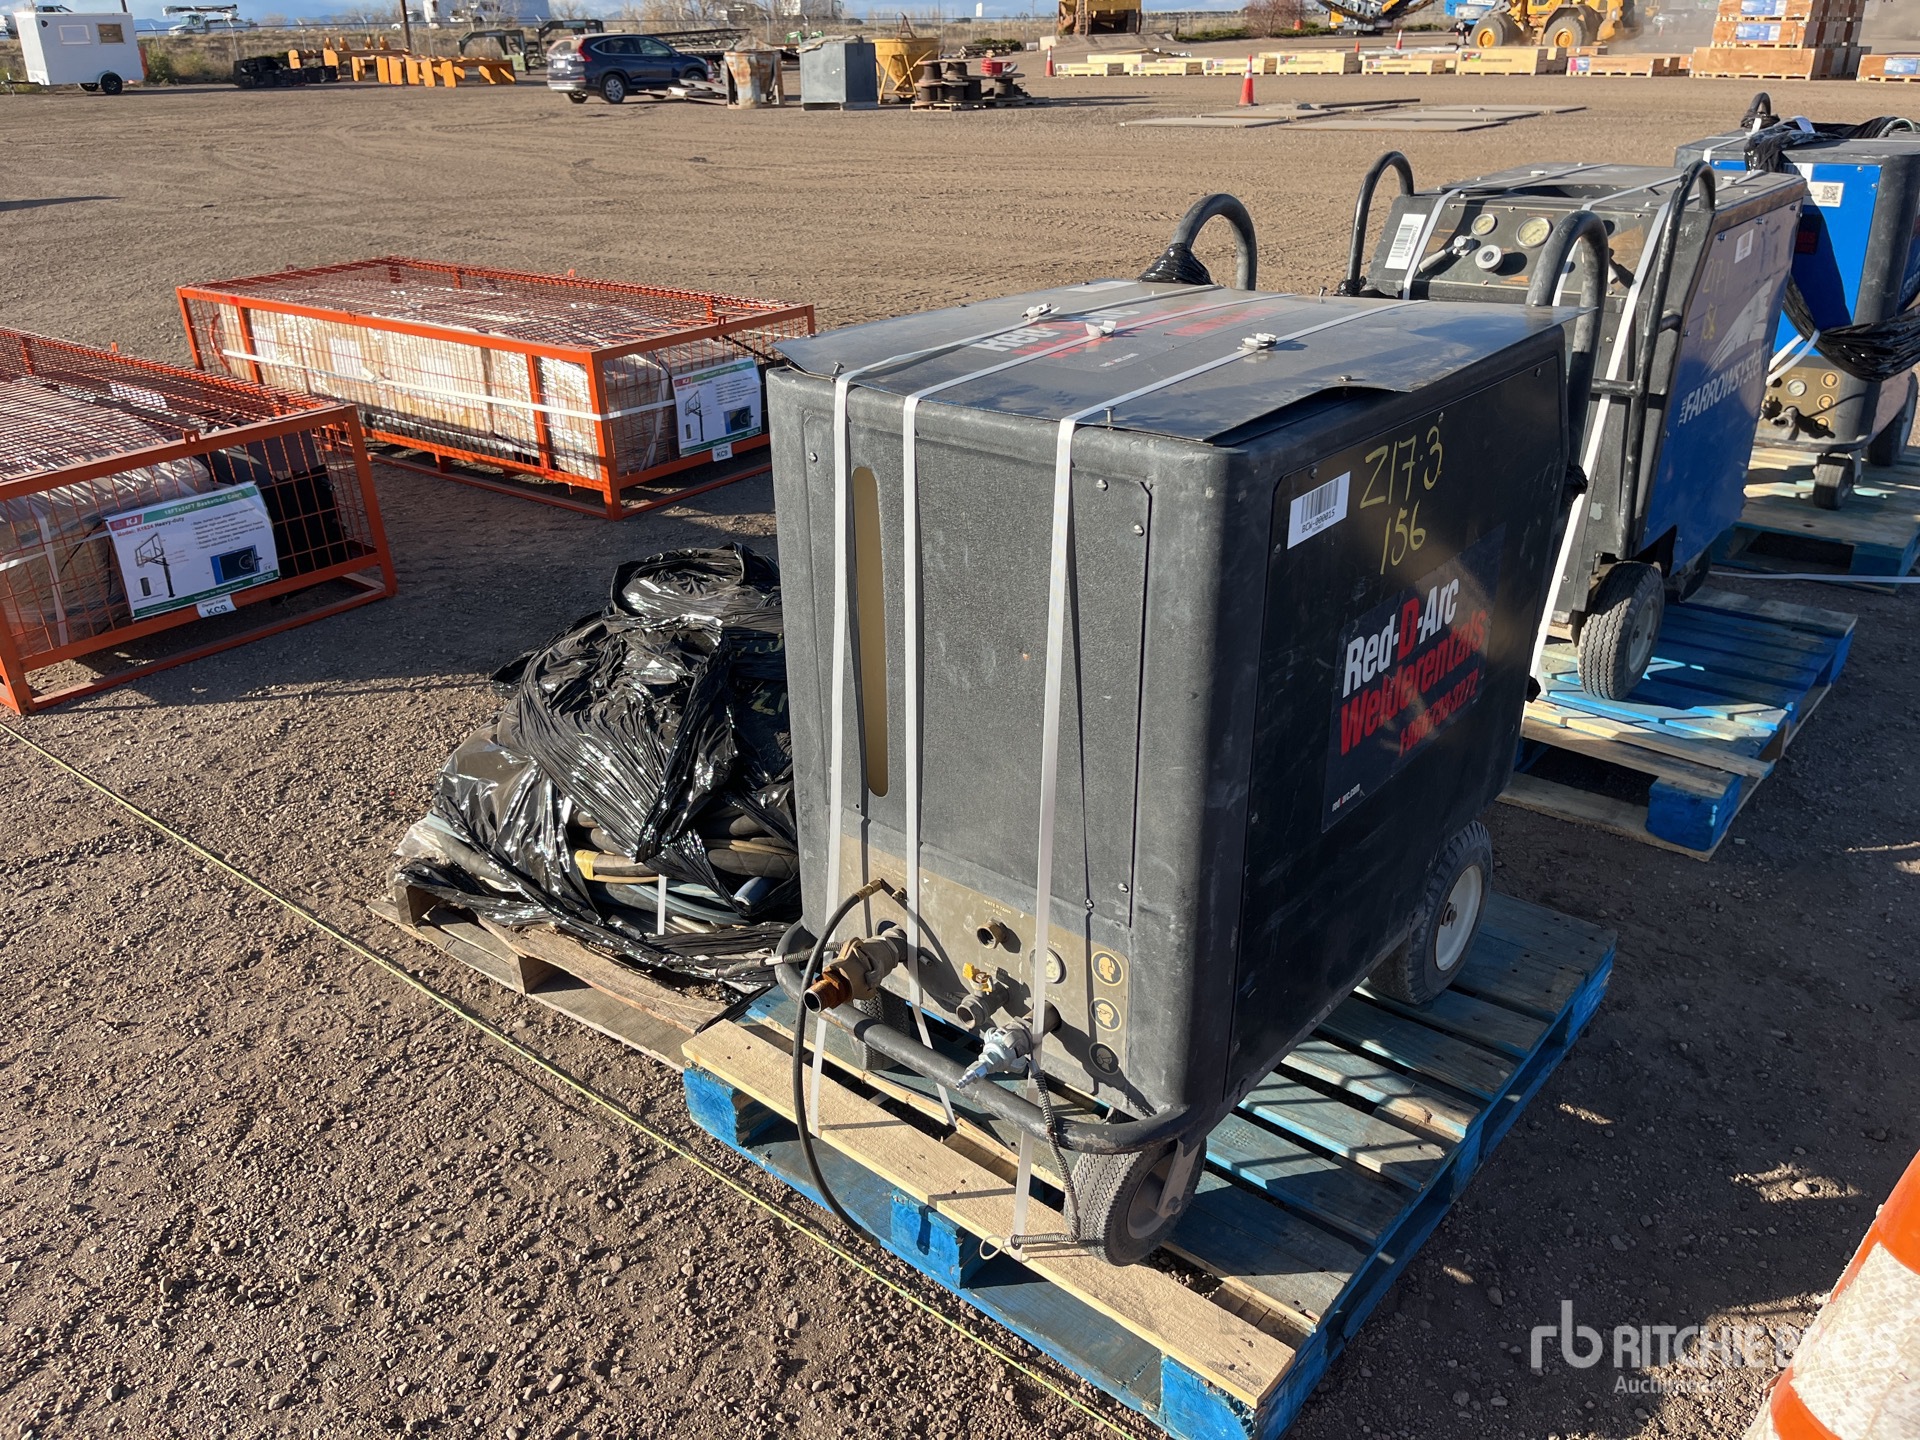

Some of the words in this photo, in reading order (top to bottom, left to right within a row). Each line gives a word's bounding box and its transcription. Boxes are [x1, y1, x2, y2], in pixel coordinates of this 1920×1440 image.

[1380, 500, 1426, 575] 156
[206, 604, 228, 615] KC9
[1342, 578, 1459, 699] Red-D-Arc
[1340, 609, 1488, 757] Welderentals
